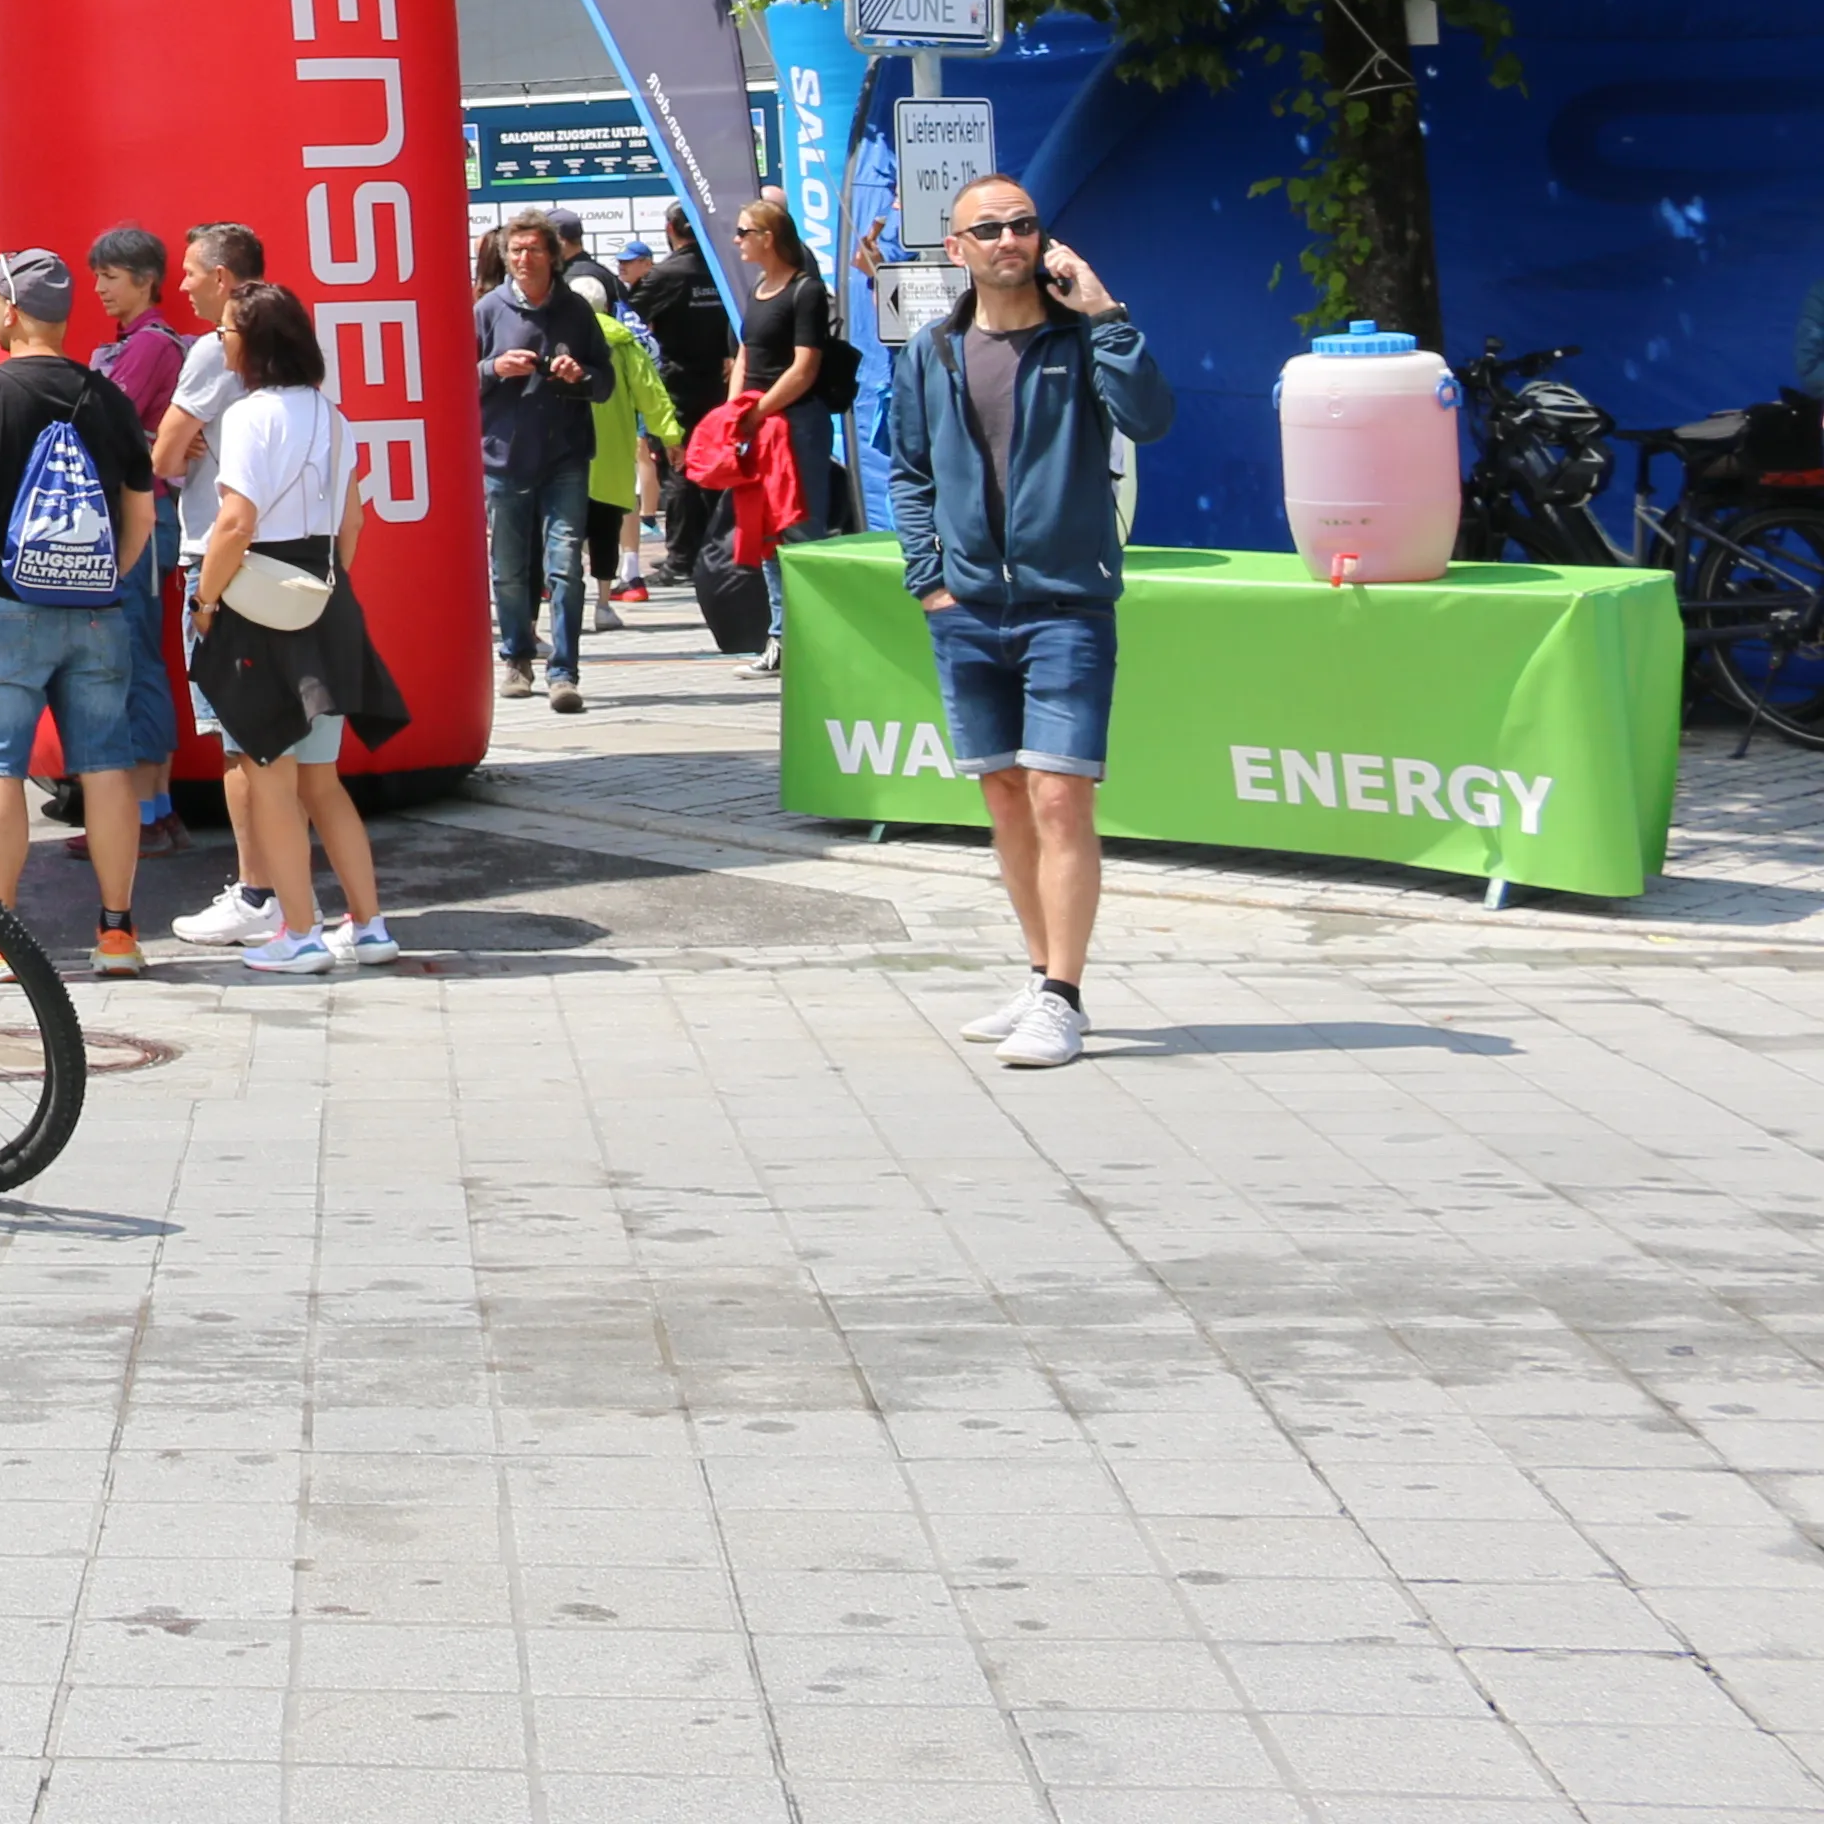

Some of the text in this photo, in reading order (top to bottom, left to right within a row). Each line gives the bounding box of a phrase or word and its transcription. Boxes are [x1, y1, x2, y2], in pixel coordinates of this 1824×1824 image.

[500, 126, 648, 144] SALOMON ZUGSPITZ ULTRA
[904, 113, 986, 144] Lieferverkehr
[790, 66, 836, 297] SALOM
[916, 167, 940, 192] von
[942, 161, 949, 191] 6
[579, 210, 623, 221] LOMON
[49, 542, 94, 553] SALOMON
[23, 549, 113, 569] ZUGSPITZ
[20, 565, 112, 581] ULTRATRAIL
[1229, 744, 1553, 835] ENERGY
